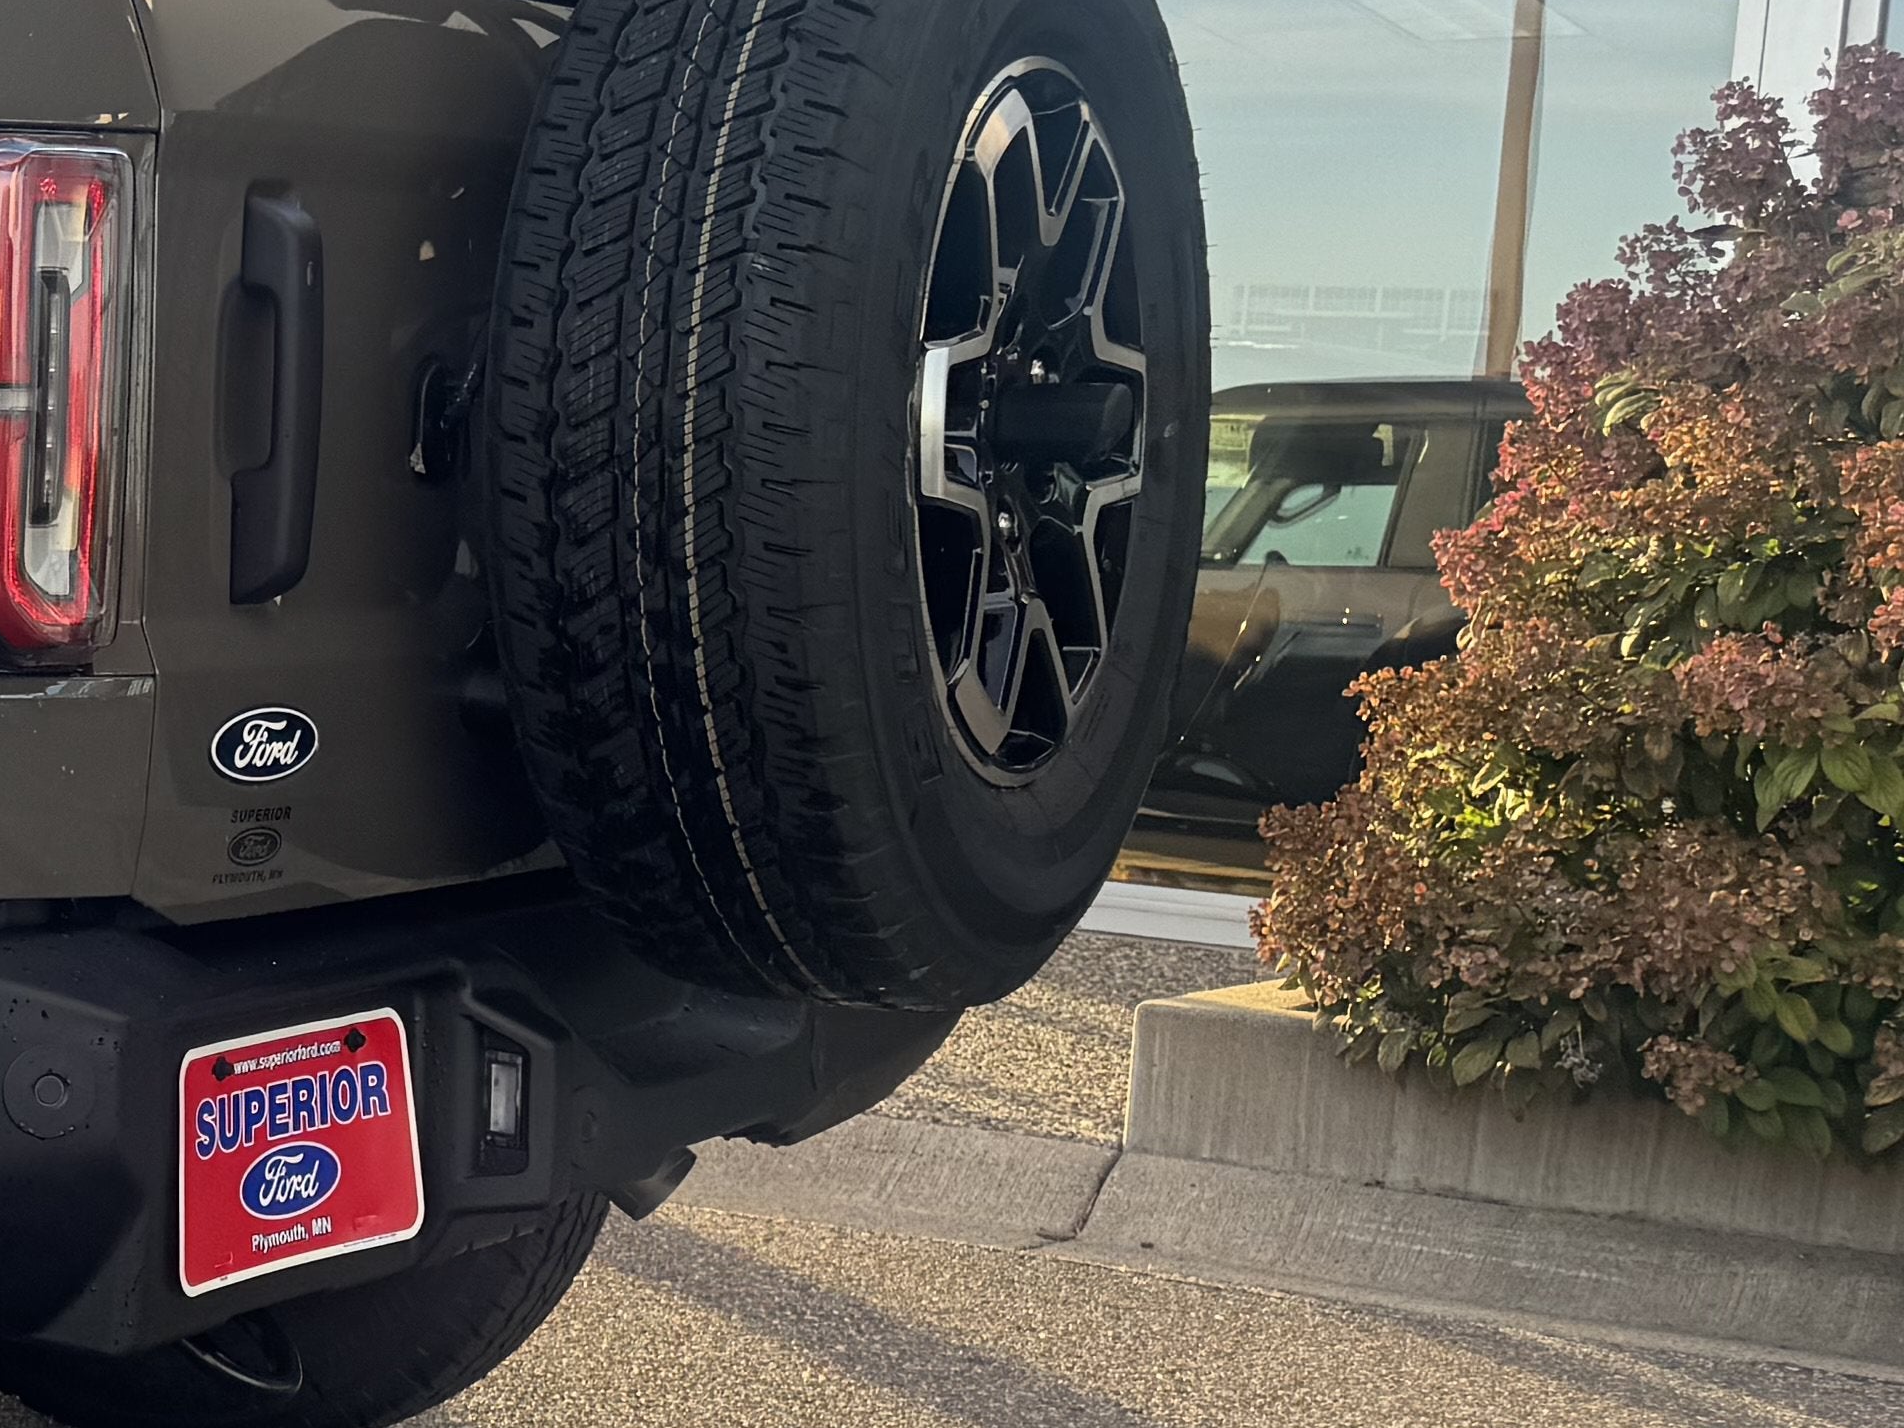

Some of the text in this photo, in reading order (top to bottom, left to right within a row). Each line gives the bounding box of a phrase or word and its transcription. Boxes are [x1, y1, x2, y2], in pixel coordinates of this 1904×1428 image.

[233, 719, 302, 769] Ford
[230, 805, 292, 824] SUPERIOR
[233, 1040, 342, 1076] www.superiorford.com
[195, 1061, 392, 1161] SUPERIOR
[258, 1153, 320, 1208] Ford
[251, 1216, 332, 1254] Plymouth, MN
